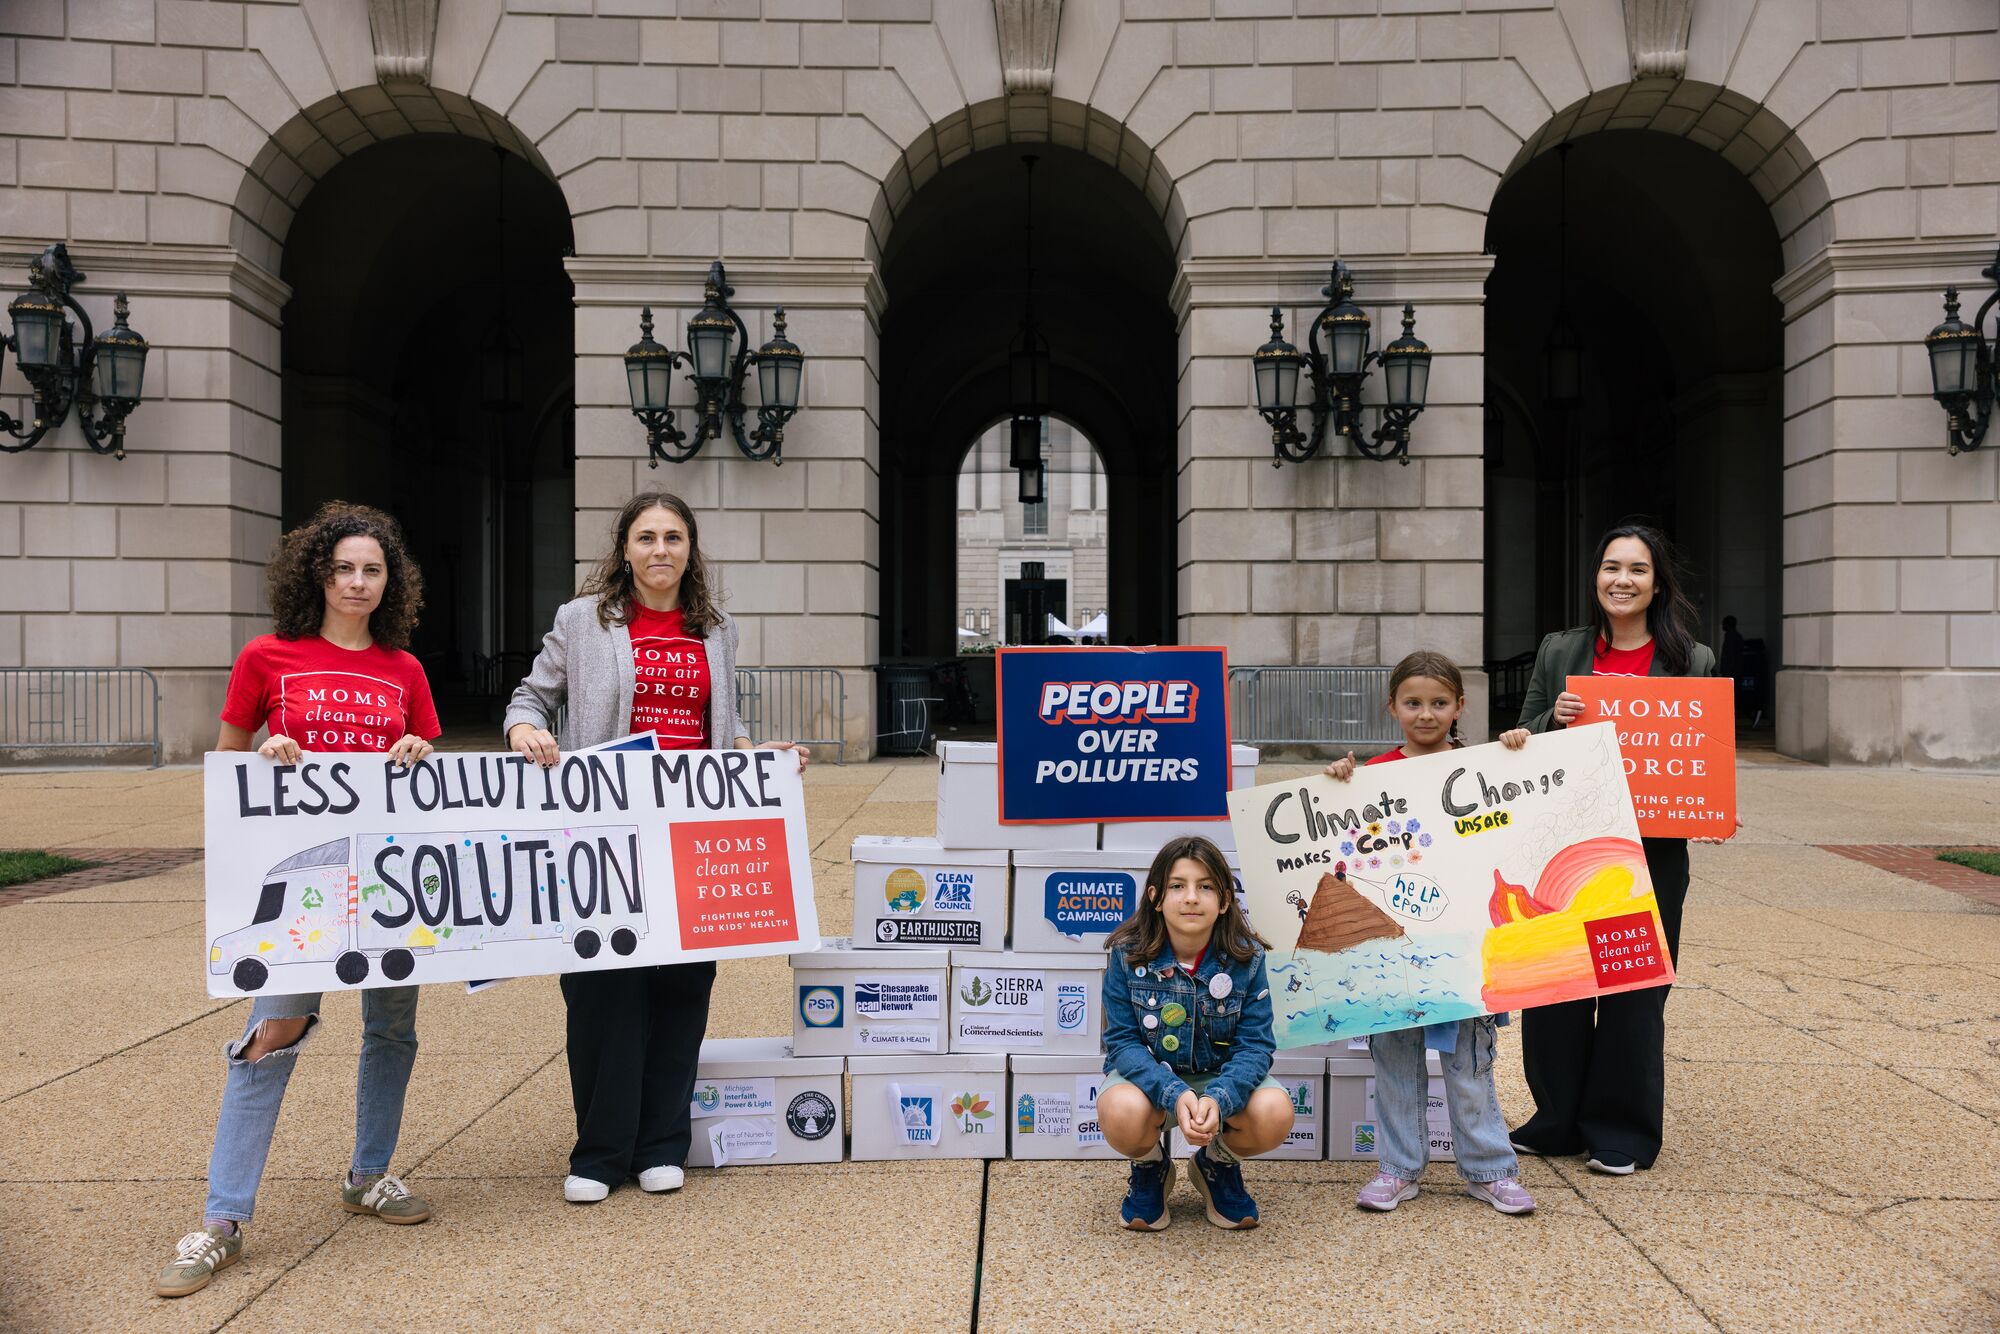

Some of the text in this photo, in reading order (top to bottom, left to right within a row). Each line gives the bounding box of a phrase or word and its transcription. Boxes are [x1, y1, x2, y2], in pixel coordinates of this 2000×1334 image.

[635, 665, 700, 679] ean air
[634, 682, 700, 698] ORCE
[307, 688, 387, 708] MOMS
[1041, 682, 1191, 718] PEOPLE
[305, 704, 391, 727] clean air
[673, 708, 691, 716] FOR
[1597, 699, 1704, 719] MOMS
[305, 730, 387, 749] FORCE
[1077, 729, 1158, 754] OVER
[1618, 726, 1705, 747] ean air
[1035, 758, 1199, 784] POLLUTERS
[1622, 758, 1707, 777] ORCE
[235, 751, 782, 817] LESS POLLUTION MORE
[1264, 767, 1566, 844] Climate Change
[1634, 795, 1705, 806] TING FOR
[1638, 809, 1724, 820] DS' HEALTH
[693, 837, 767, 854] MOMS
[696, 857, 770, 877] clean air
[935, 872, 974, 884] CLEAN
[696, 881, 773, 899] FORCE
[934, 884, 972, 902] AIR
[1057, 882, 1124, 895] CLIMATE
[934, 902, 972, 910] COUNCIL
[1057, 896, 1123, 910] ACTION
[701, 909, 775, 922] FIGHTING FOR
[1057, 911, 1123, 922] CAMPAIGN
[692, 919, 789, 933] OUR KIDS' HEALTH
[900, 921, 979, 937] EARTHJUSTICE
[1595, 926, 1648, 944] MOMS
[1599, 940, 1652, 959] clean air
[1601, 955, 1656, 974] FORCE
[881, 984, 929, 994] Chesapeake
[995, 977, 1044, 992] SIERRA
[808, 998, 835, 1010] PSR
[881, 993, 938, 1002] Climate Action
[995, 992, 1028, 1006] CLUB
[881, 1002, 913, 1011] Network
[964, 1028, 1044, 1037] Concerned Scientists
[724, 1092, 757, 1100] Interfaith
[1038, 1098, 1070, 1106] California
[754, 1100, 772, 1109] Light
[1038, 1105, 1070, 1113] Interfaith
[1427, 1100, 1444, 1108] icle
[965, 1113, 984, 1133] bn
[1038, 1113, 1071, 1124] Power
[1037, 1124, 1070, 1135] & Light
[1078, 1121, 1102, 1133] GRE
[744, 1131, 765, 1139] Nurses
[906, 1128, 932, 1141] TIZEN
[1286, 1131, 1314, 1140] reen
